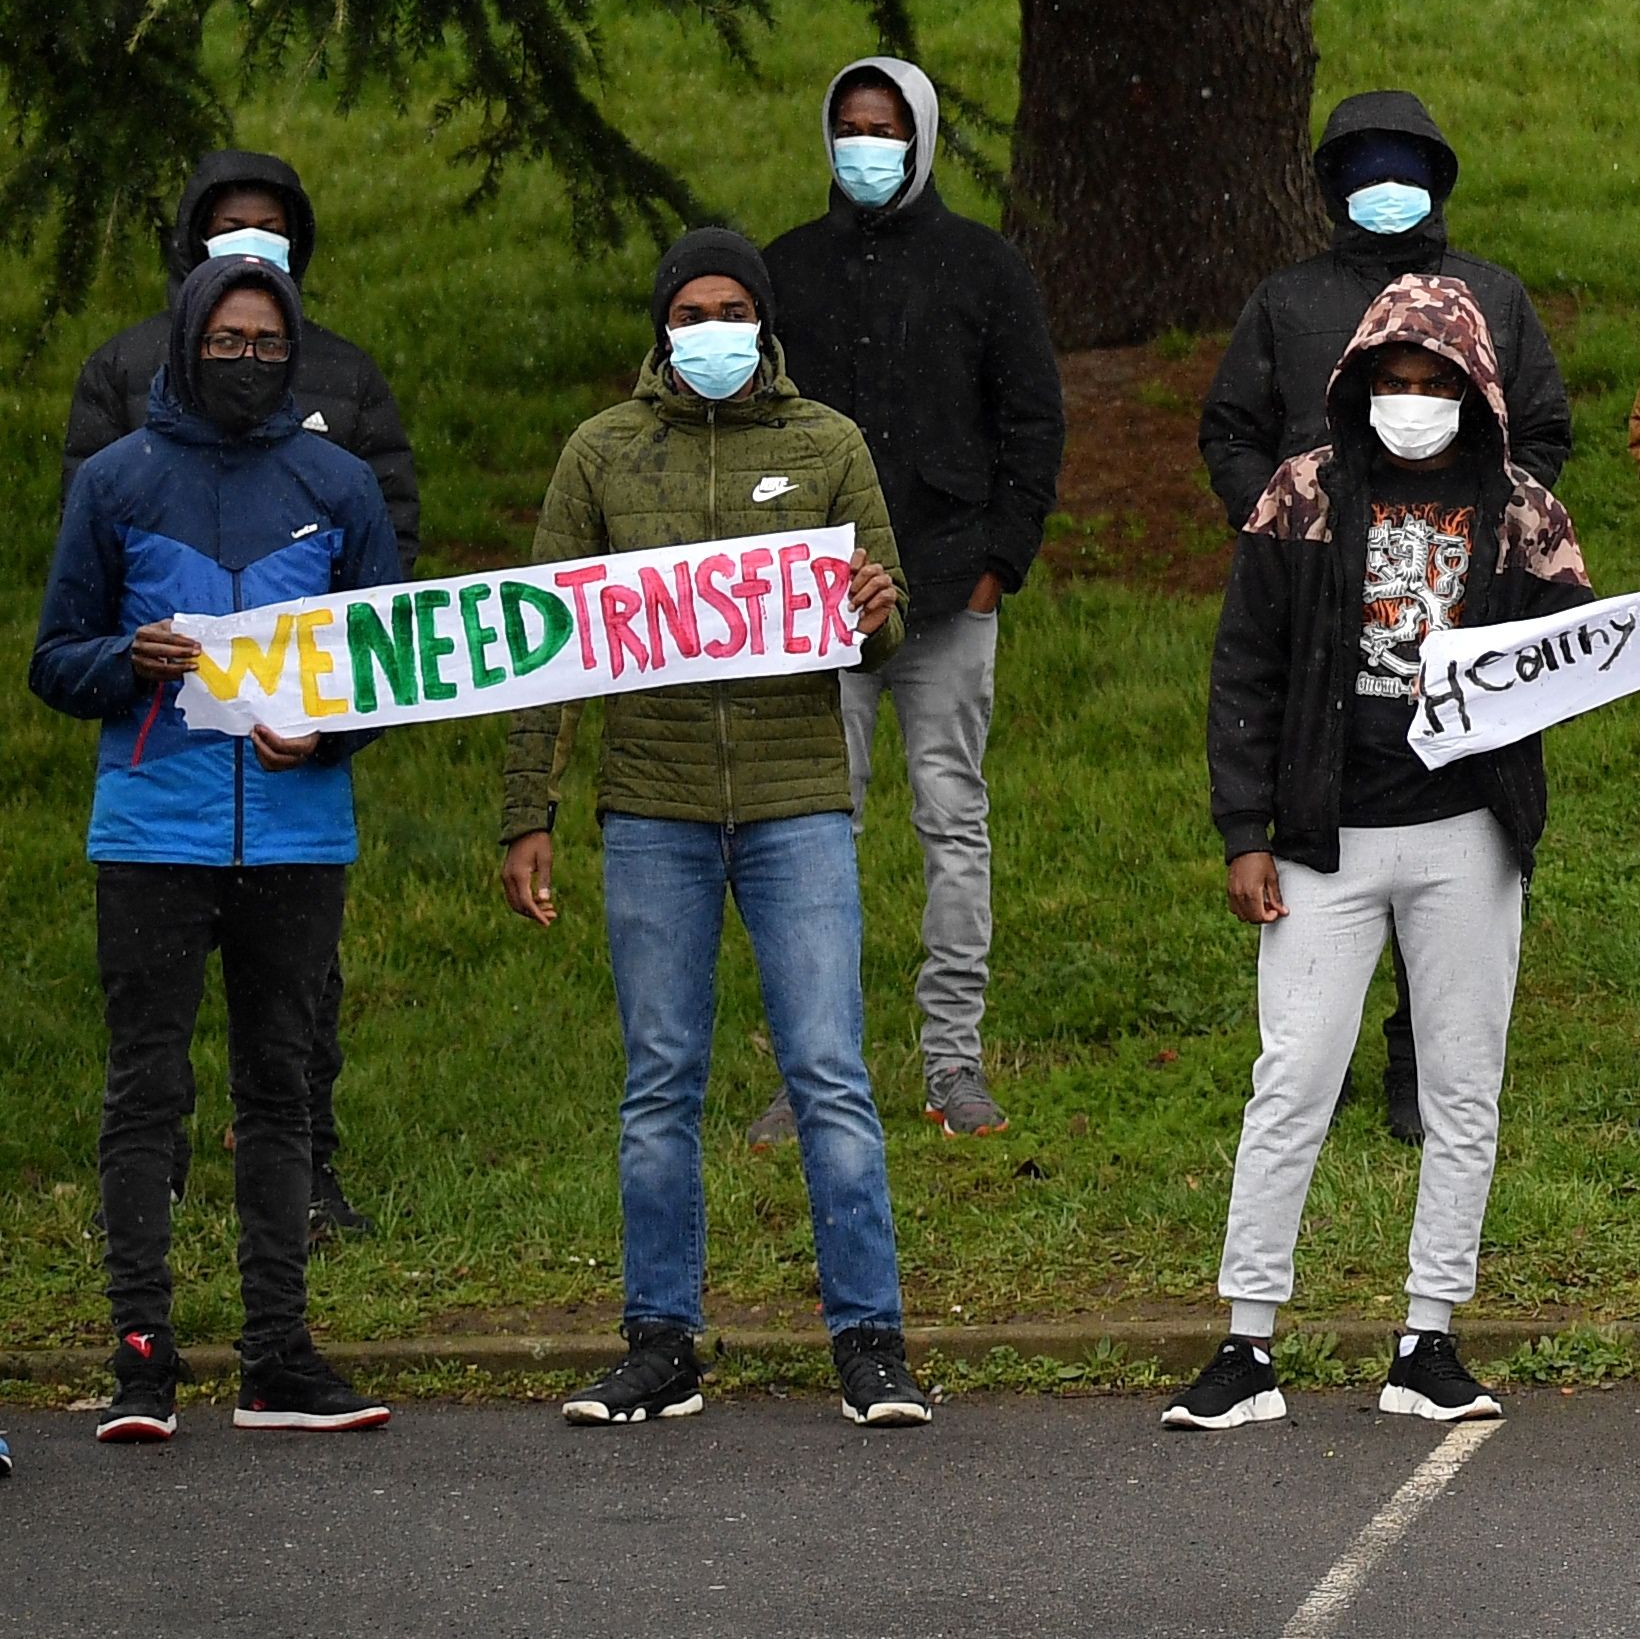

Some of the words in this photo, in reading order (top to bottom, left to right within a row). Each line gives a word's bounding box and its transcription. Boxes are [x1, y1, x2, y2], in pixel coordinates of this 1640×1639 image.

[194, 609, 349, 717] WE
[347, 581, 573, 714] NEED
[555, 543, 855, 679] TRNSFER
